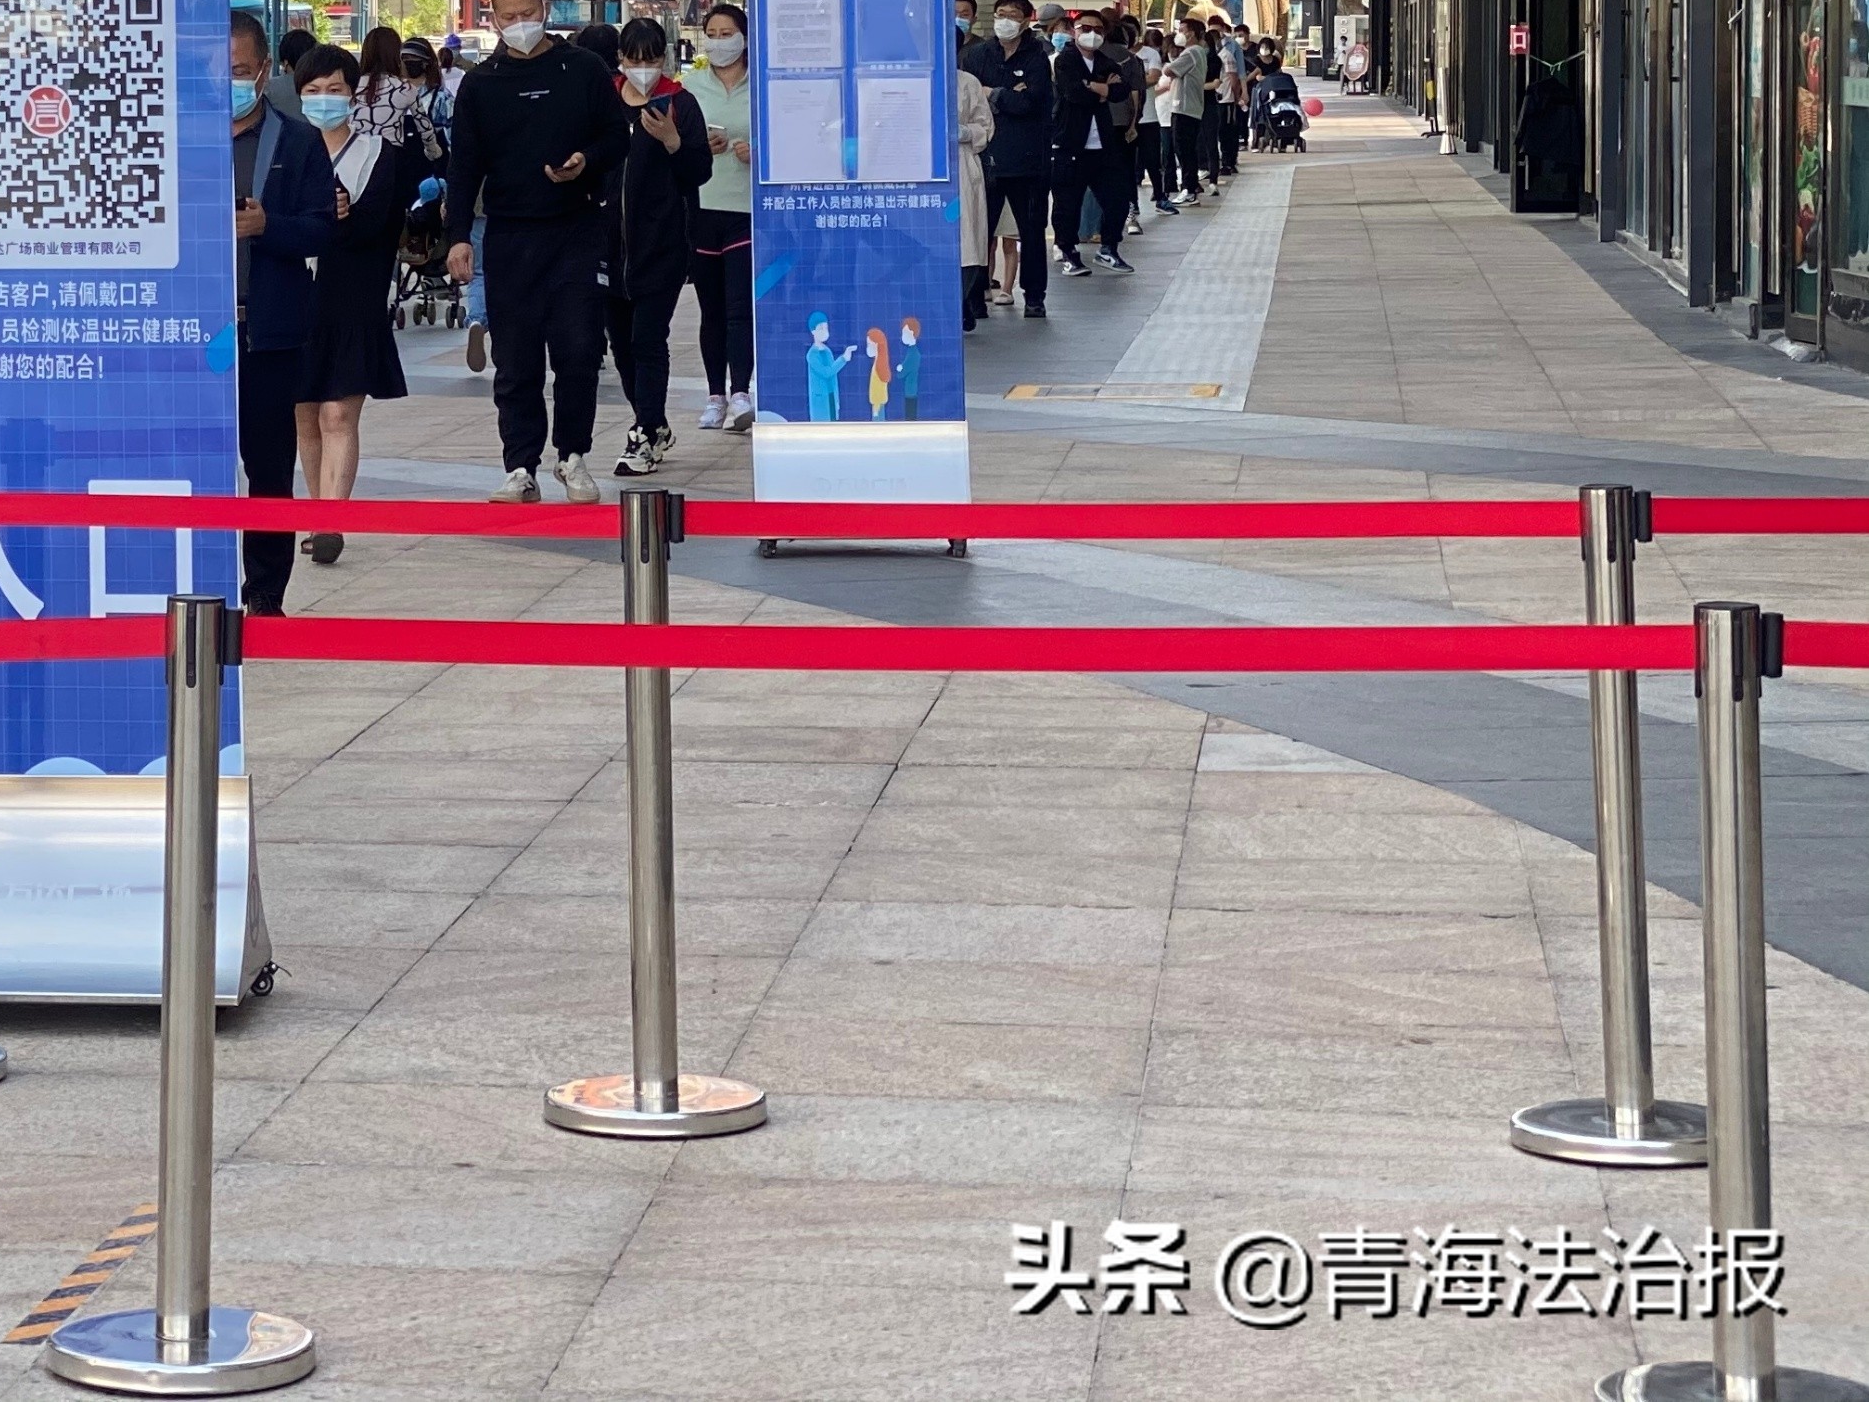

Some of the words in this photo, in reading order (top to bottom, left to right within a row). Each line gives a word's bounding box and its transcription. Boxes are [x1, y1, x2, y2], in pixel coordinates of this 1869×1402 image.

[815, 214, 888, 229] 谢谢您的配合！
